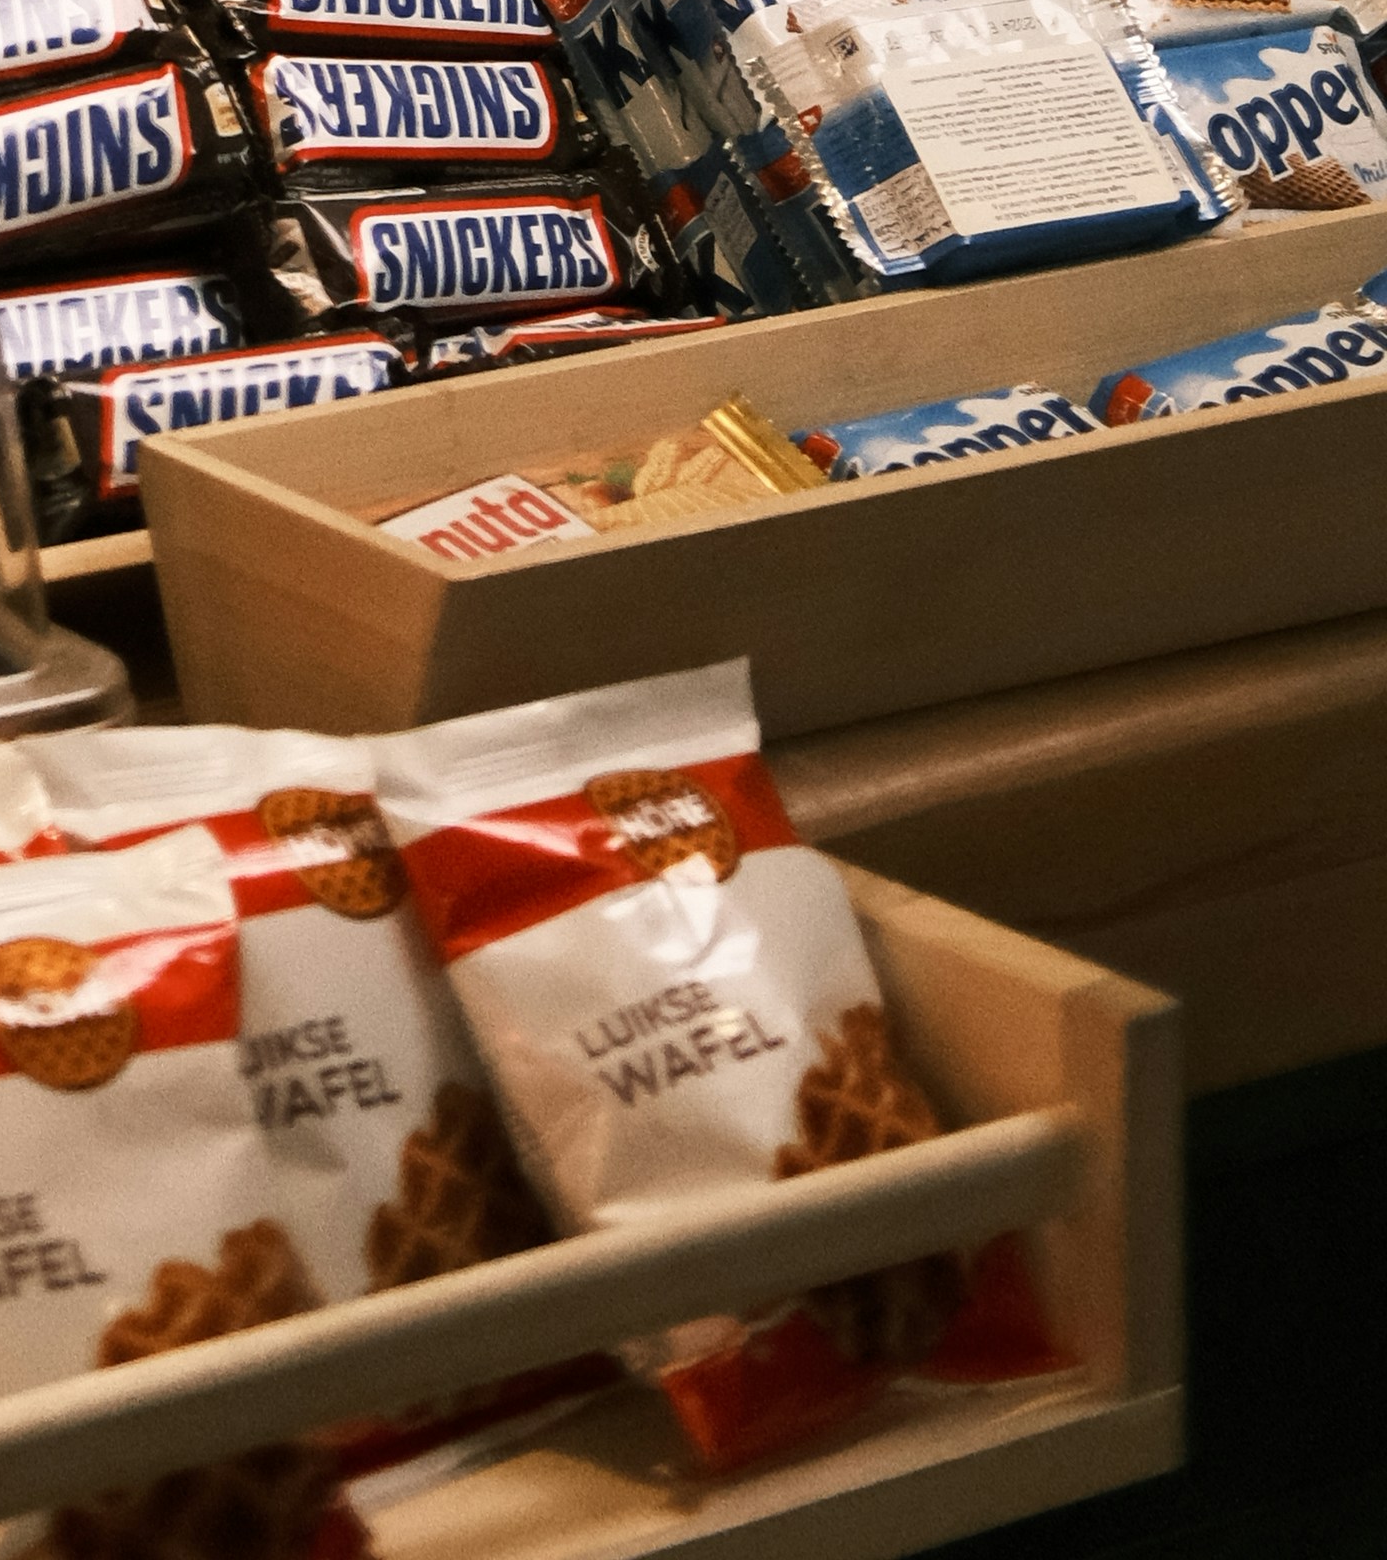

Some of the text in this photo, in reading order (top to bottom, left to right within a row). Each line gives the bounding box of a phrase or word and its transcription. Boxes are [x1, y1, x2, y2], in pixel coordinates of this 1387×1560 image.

[371, 211, 609, 304] SNICKERS
[575, 980, 722, 1060] LUIKSE
[595, 1008, 785, 1109] WAFEL
